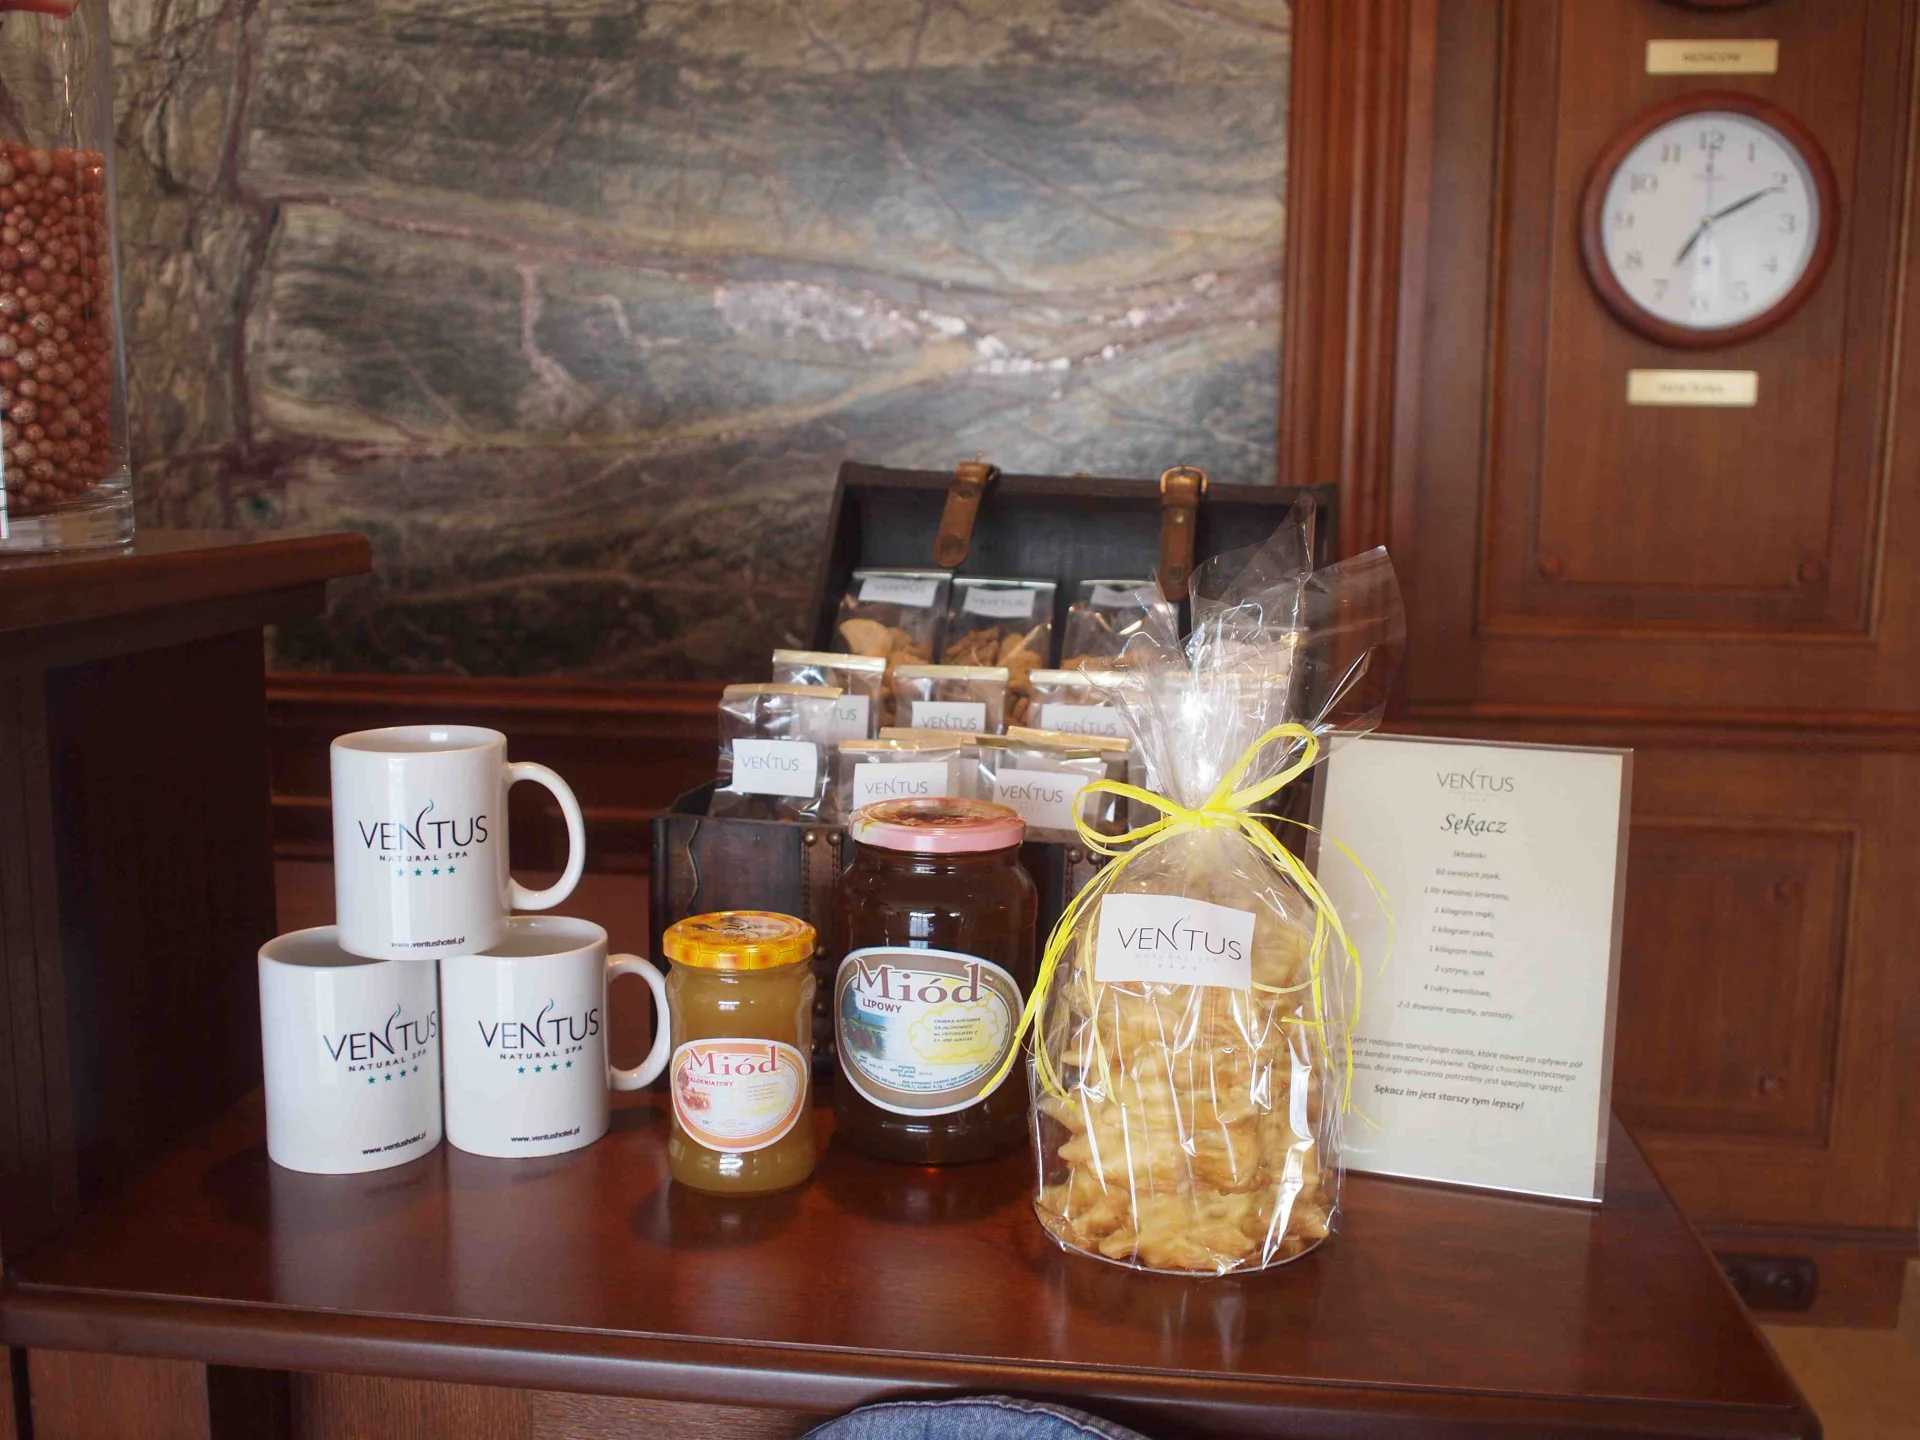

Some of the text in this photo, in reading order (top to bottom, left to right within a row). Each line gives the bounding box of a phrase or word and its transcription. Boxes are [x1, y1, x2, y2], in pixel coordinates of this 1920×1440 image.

[1699, 129, 1725, 151] 12
[1660, 143, 1681, 163] 11
[1747, 142, 1756, 163] 1
[1630, 173, 1659, 193] 10
[1770, 171, 1788, 192] 2
[1777, 213, 1795, 234] 3
[1653, 278, 1669, 299] 7
[921, 714, 977, 730] VENTUS
[1054, 715, 1117, 735] VENTUS
[741, 753, 799, 772] VENTUS
[864, 777, 928, 795] VENTUS
[1437, 768, 1514, 792] VENTUS
[999, 783, 1064, 803] VENTUS
[358, 803, 488, 850] VENTUS
[1440, 812, 1508, 836] Sękacz
[379, 850, 468, 862] NATURAL SPA
[391, 936, 465, 949] www.ventushotel.pl
[1117, 917, 1242, 961] VENTUS
[853, 958, 983, 1004] Miód
[862, 998, 902, 1013] LIPOWY
[323, 1006, 437, 1062] VENTUS
[478, 1002, 599, 1049] VENTUS
[500, 1044, 583, 1060] NATURAL SPA
[1369, 1038, 1403, 1048] rodzajem
[1405, 1042, 1449, 1053] specjalnego
[348, 1048, 426, 1072] NATURAL SPA
[687, 1045, 780, 1075] Miód
[1365, 1050, 1390, 1059] bardzo
[1392, 1054, 1425, 1064] smaczne
[1374, 1063, 1384, 1071] do
[1484, 1077, 1499, 1085] jest
[1373, 1084, 1525, 1111] Sękacz im jest starszy tym lepszy!
[362, 1130, 427, 1155] www.ventushotel.pl
[511, 1126, 580, 1143] www.ventushotel.pl
